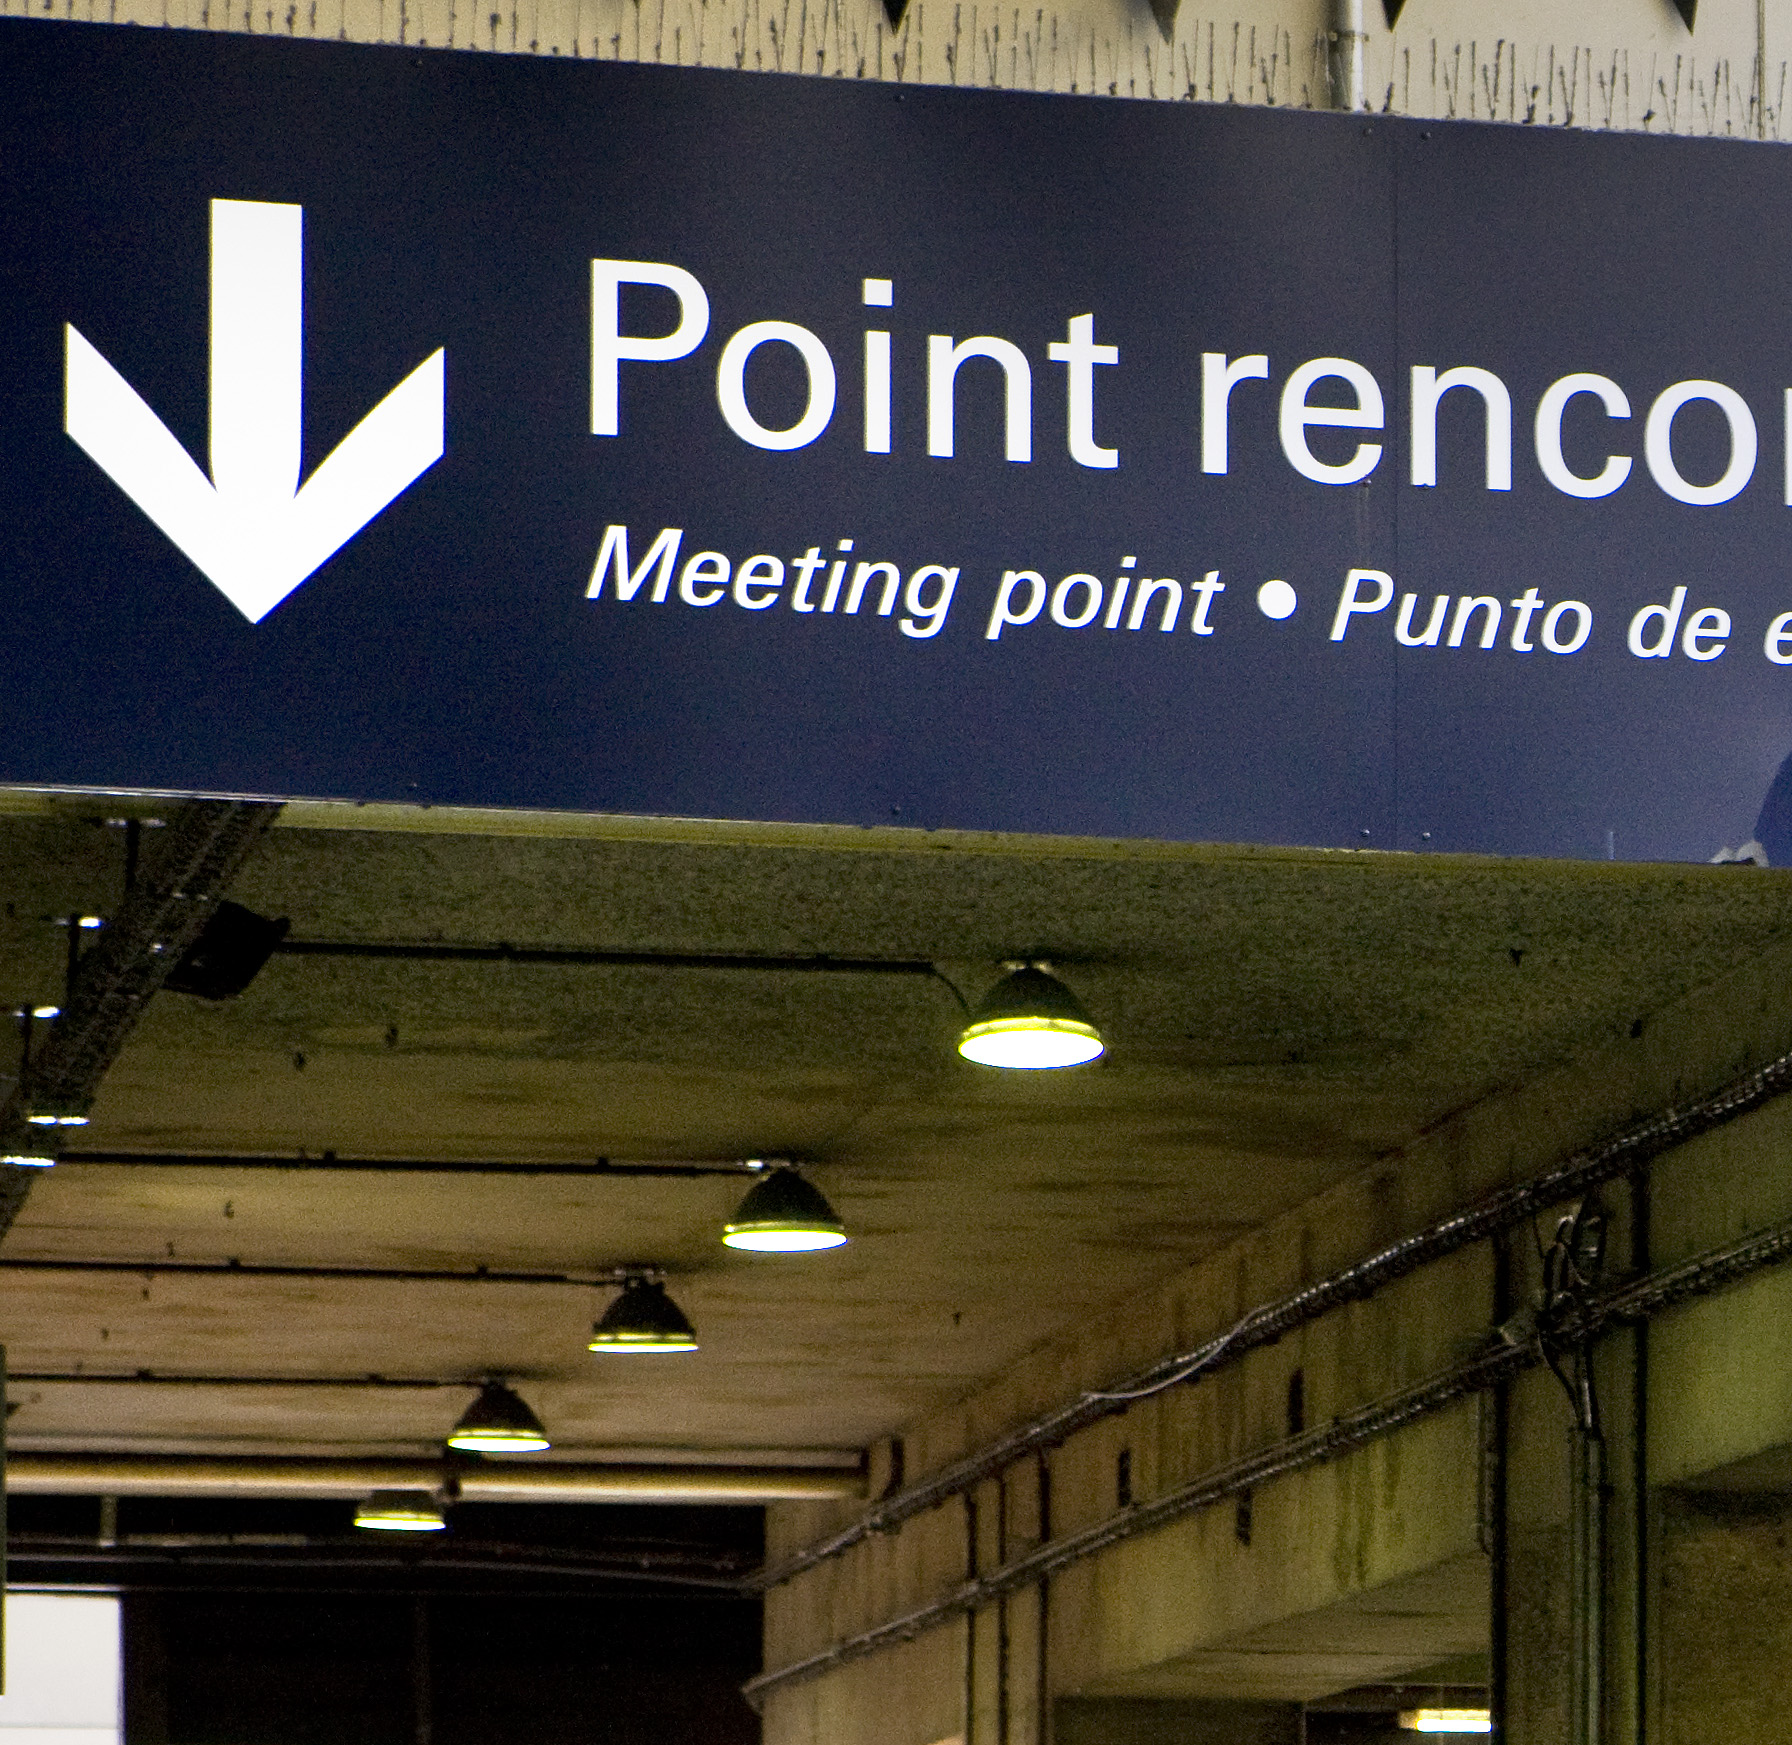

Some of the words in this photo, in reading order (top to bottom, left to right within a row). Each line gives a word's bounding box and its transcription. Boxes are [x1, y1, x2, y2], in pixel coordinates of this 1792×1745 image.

[590, 258, 1120, 470] Point
[585, 524, 961, 639] Meeting
[985, 555, 1227, 641] point
[1329, 568, 1593, 655] Punto
[1627, 585, 1732, 662] de
